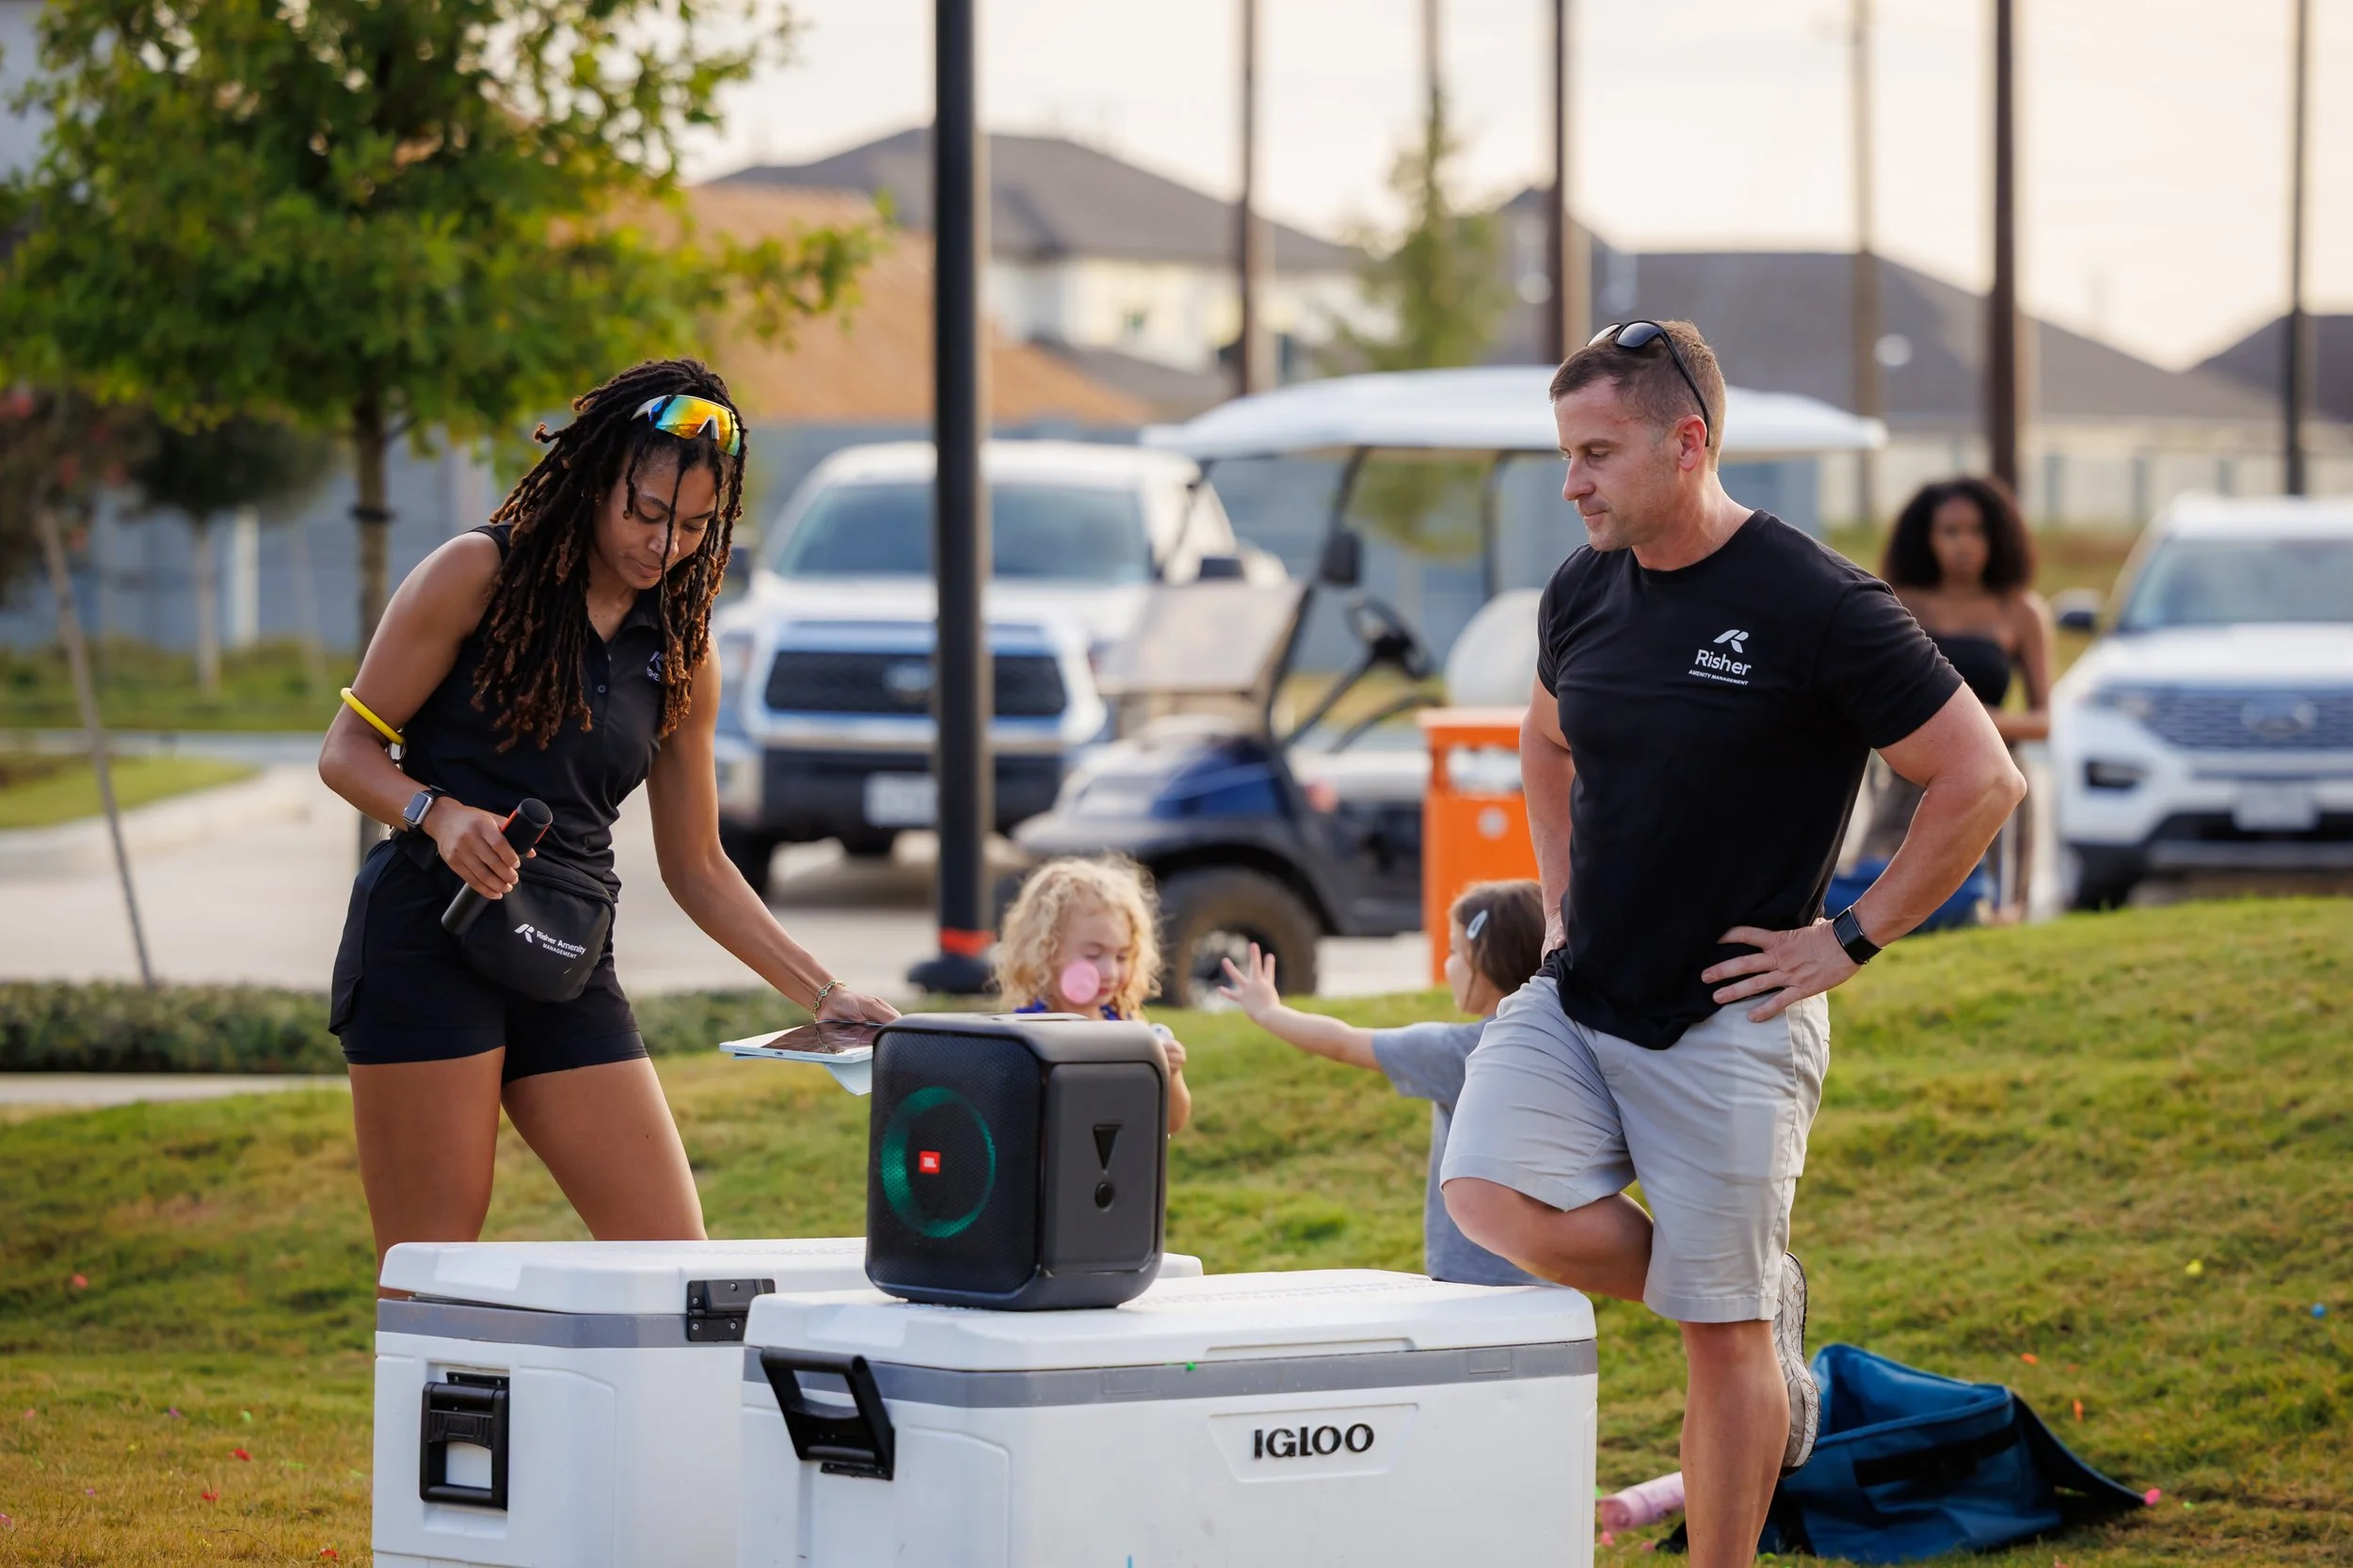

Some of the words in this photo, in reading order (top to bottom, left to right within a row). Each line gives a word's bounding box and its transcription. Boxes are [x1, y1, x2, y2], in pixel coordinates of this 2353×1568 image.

[1694, 648, 1752, 676] Risher
[1689, 669, 1711, 679] AMENITY
[1711, 674, 1749, 685] MANAGEMENT
[536, 930, 556, 945] Risher
[557, 939, 587, 955] Amenity
[542, 943, 577, 959] MANAGEMENT
[1255, 1424, 1374, 1459] IGLOO
